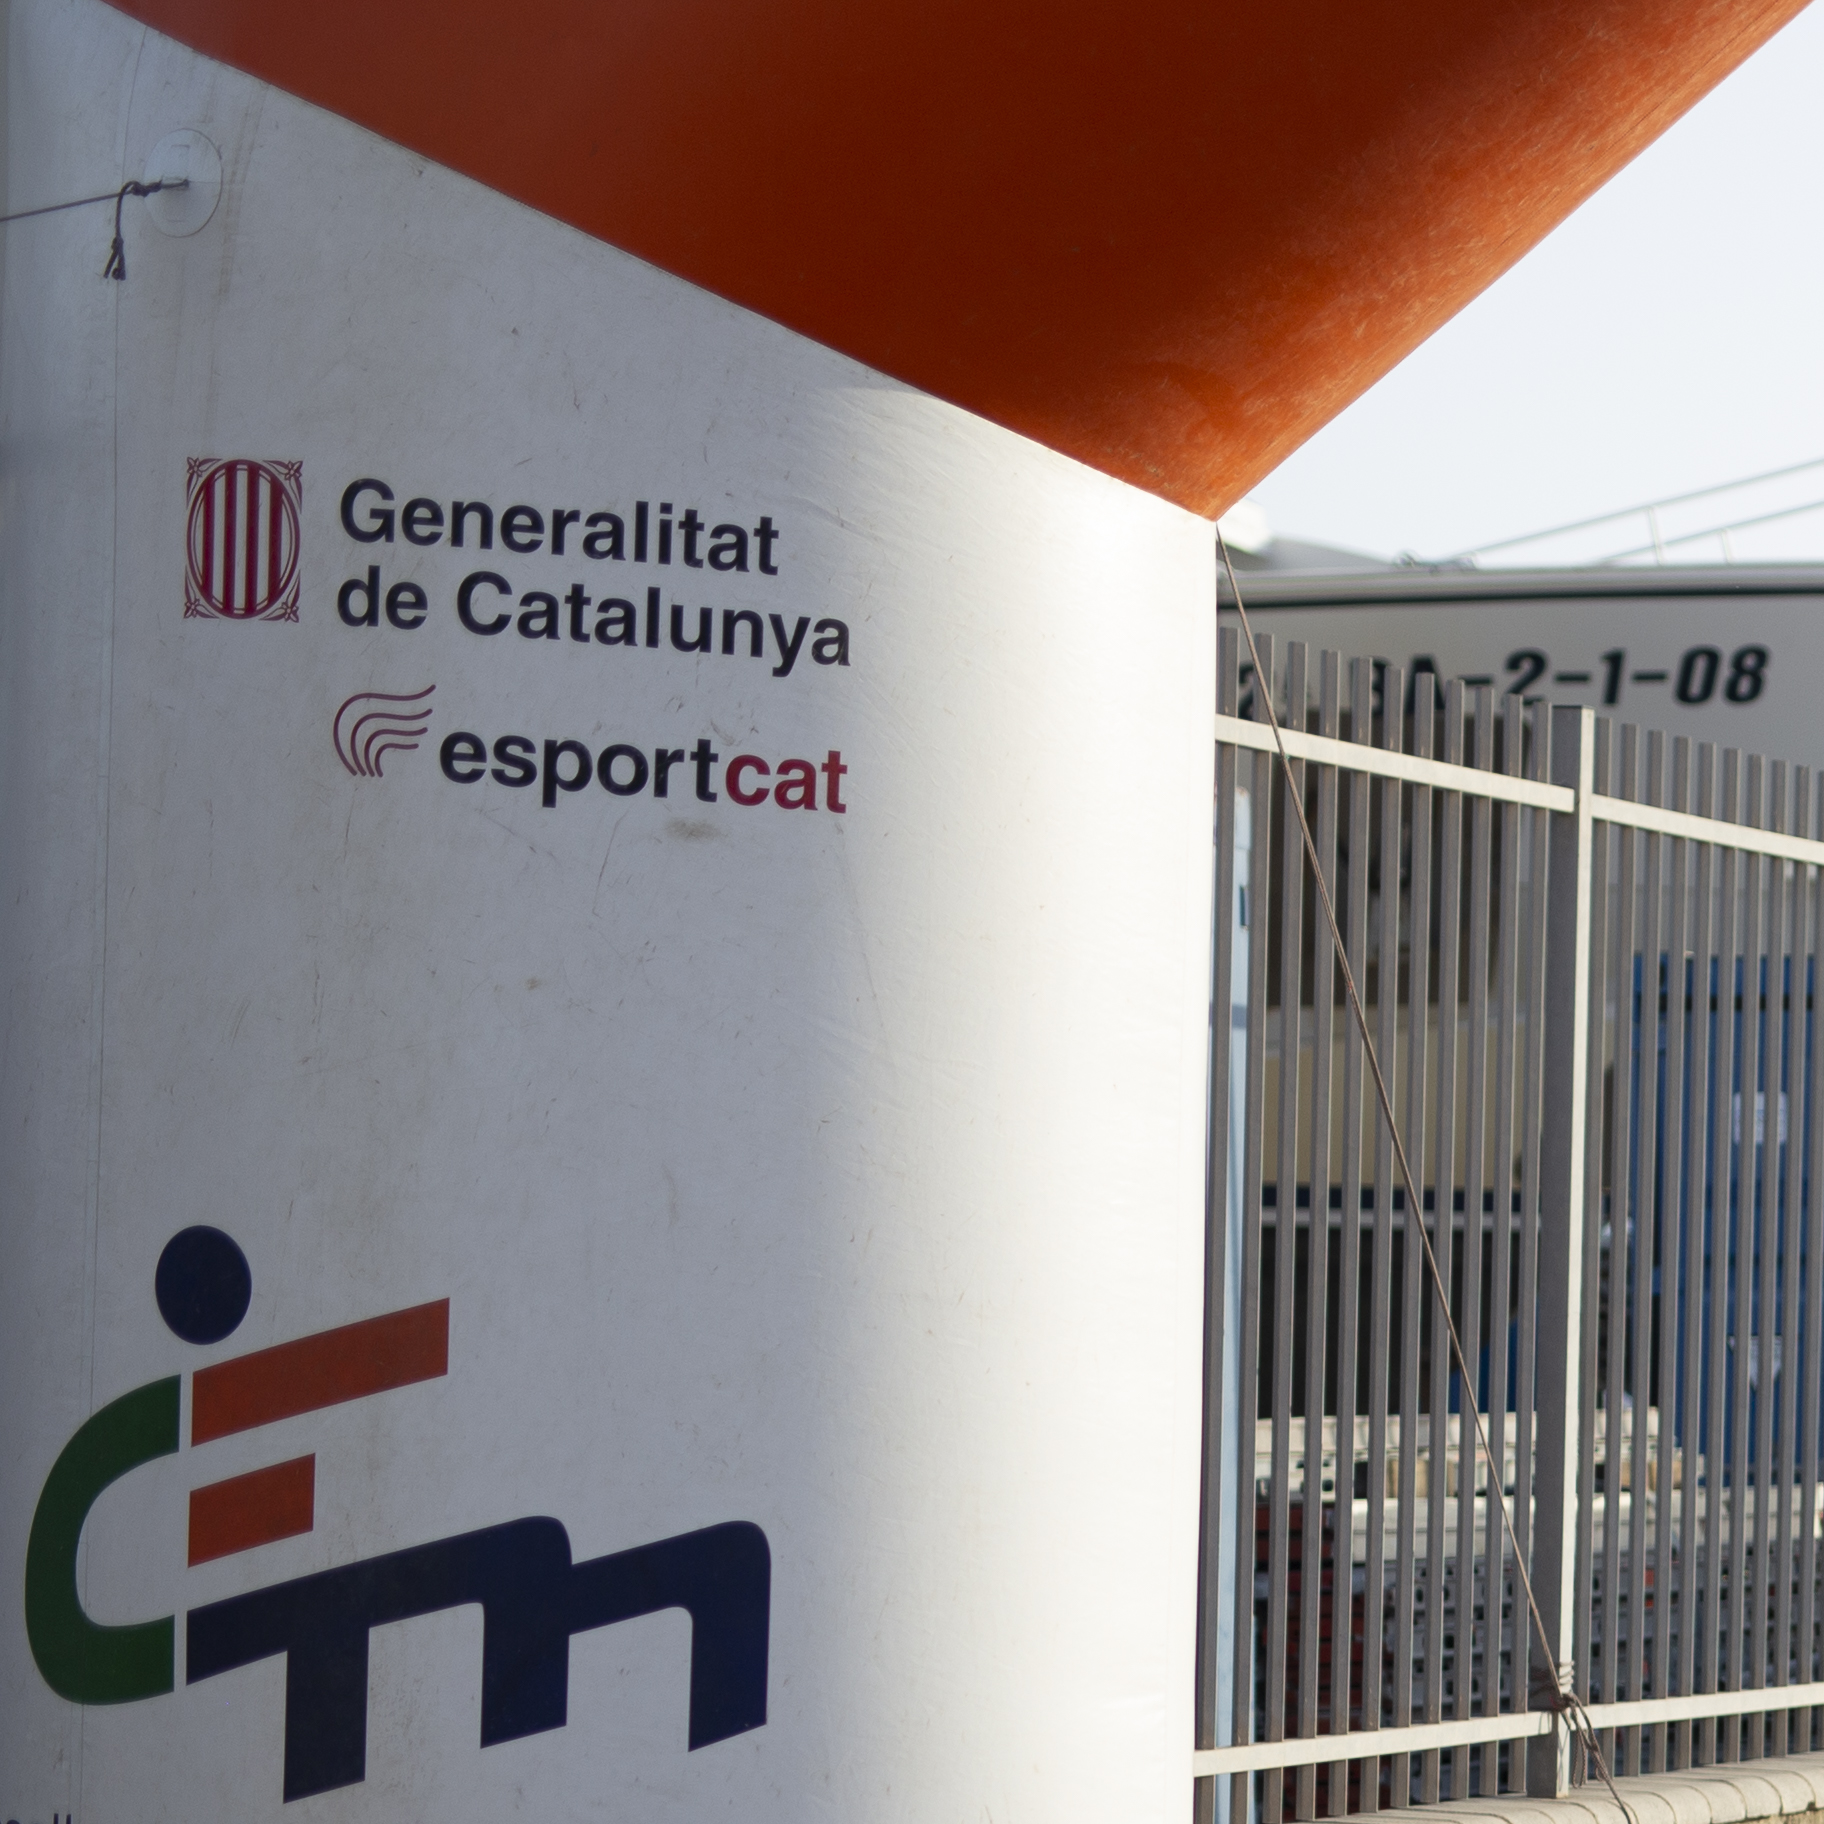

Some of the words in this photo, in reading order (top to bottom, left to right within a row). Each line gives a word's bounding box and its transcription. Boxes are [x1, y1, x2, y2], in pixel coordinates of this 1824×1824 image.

[339, 476, 781, 578] Generalitat
[335, 563, 429, 632] de
[455, 569, 852, 679] Catalunya
[438, 730, 849, 815] esportcat
